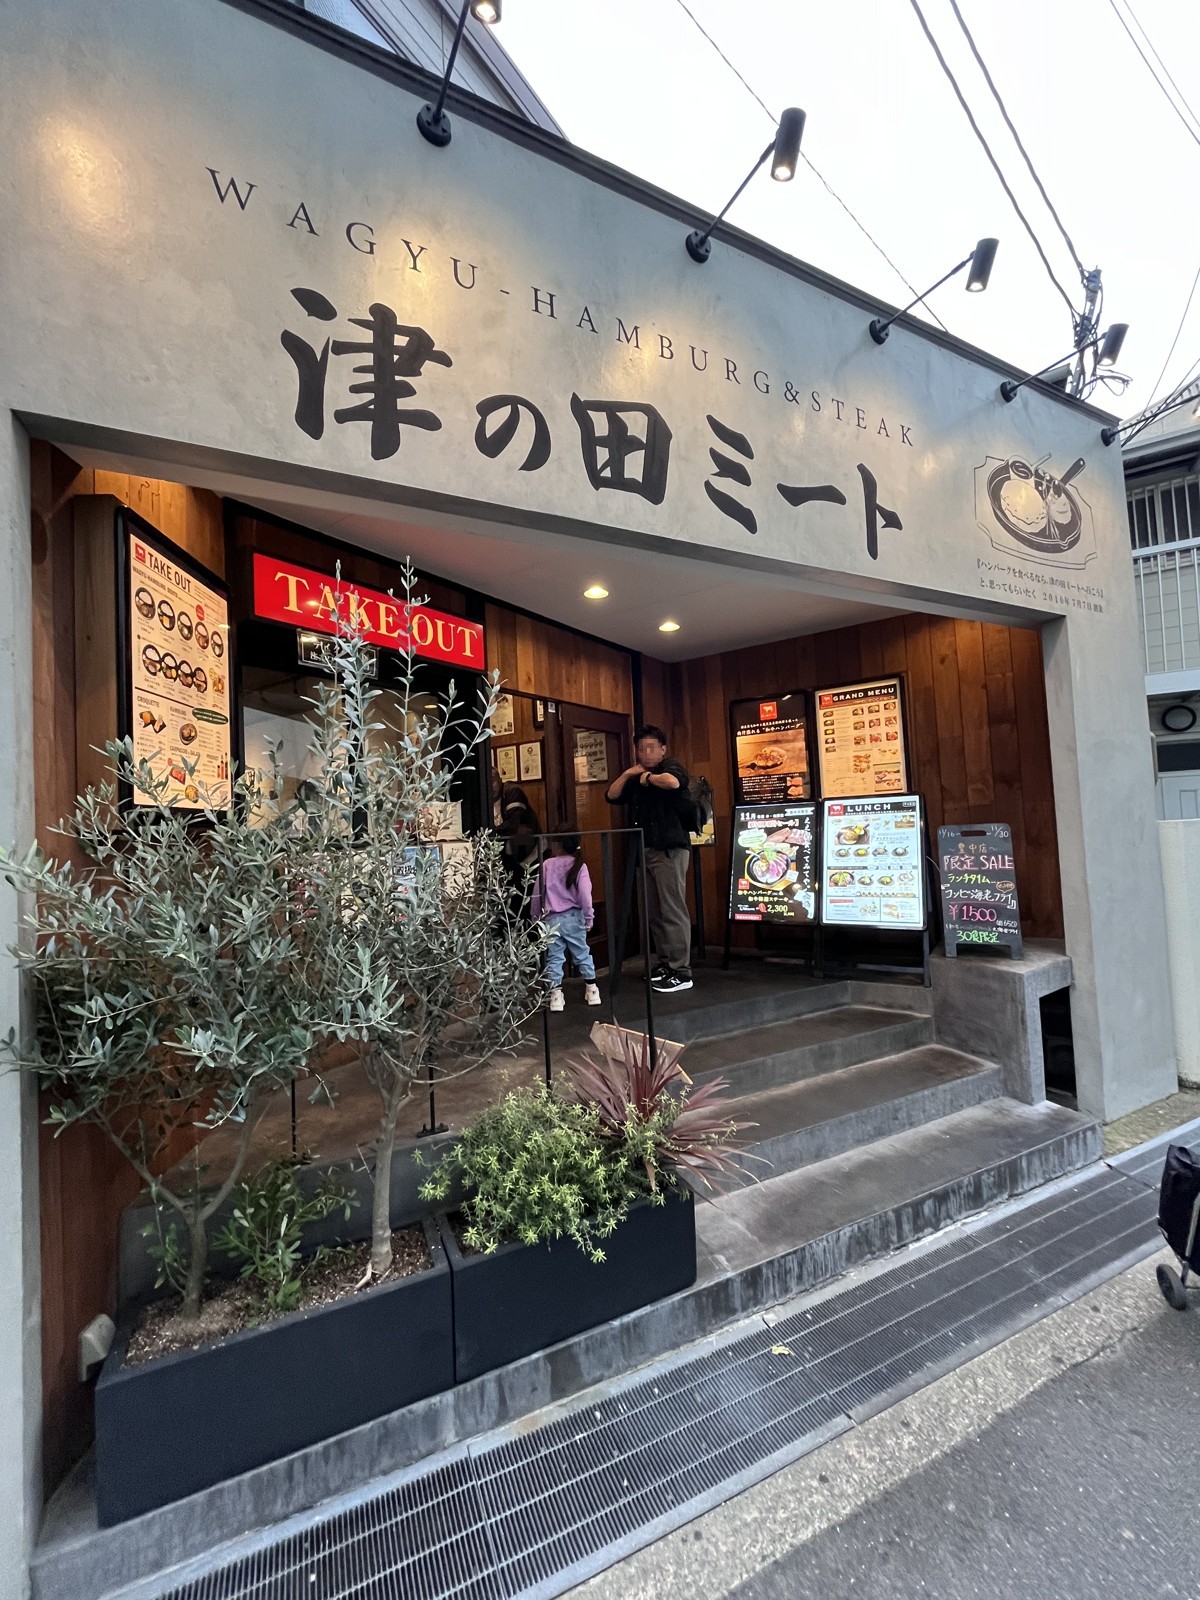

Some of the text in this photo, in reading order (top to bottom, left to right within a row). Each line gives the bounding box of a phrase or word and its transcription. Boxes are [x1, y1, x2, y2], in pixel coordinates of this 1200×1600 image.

[281, 287, 904, 560] 津の田ミート
[148, 551, 172, 581] TAKE
[174, 570, 191, 593] OUT
[274, 571, 399, 639] TAKE
[411, 613, 478, 658] OUT
[832, 687, 894, 702] GRAND MENU
[847, 803, 891, 812] LUNCH
[943, 854, 1014, 871] 限定 SALE
[767, 904, 788, 914] 2,300
